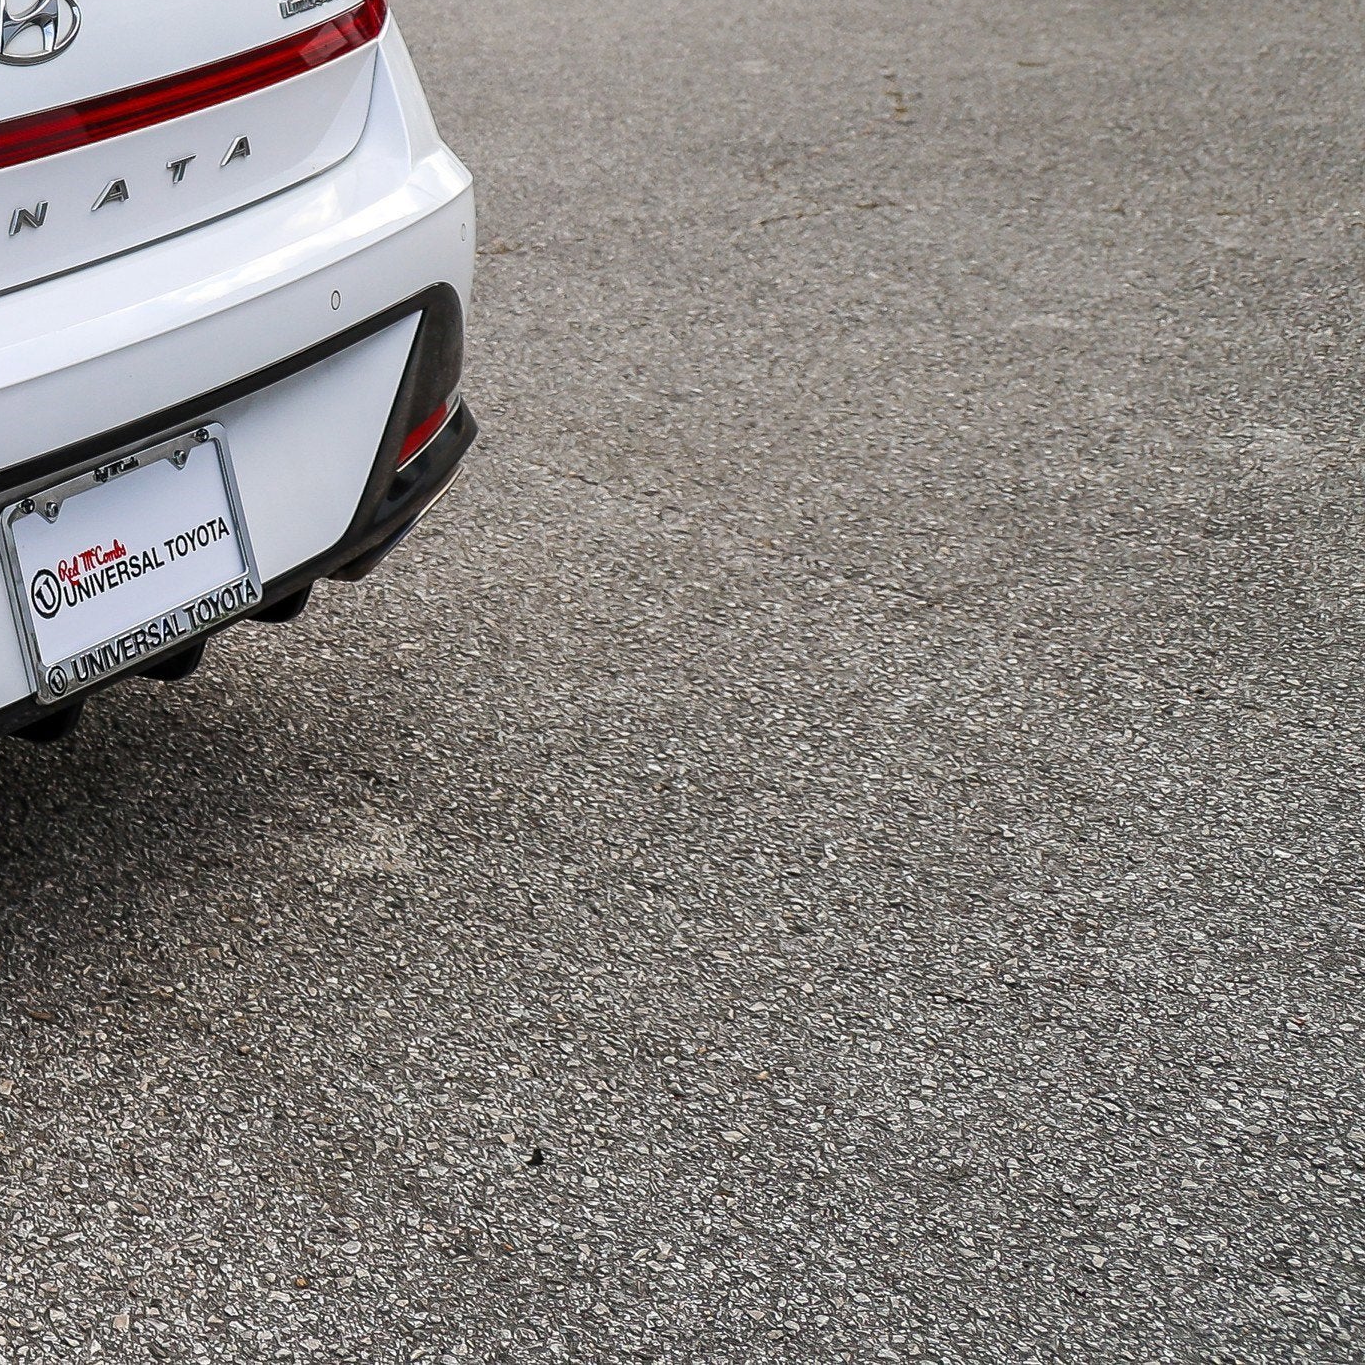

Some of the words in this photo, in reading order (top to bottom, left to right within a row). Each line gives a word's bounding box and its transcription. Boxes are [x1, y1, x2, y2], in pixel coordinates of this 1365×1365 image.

[58, 559, 80, 587] Red
[62, 549, 165, 608] UNIVERSAL
[163, 516, 230, 562] TOYOTA
[70, 612, 187, 682] UNIVERSAL
[182, 578, 258, 630] TOYOTA
